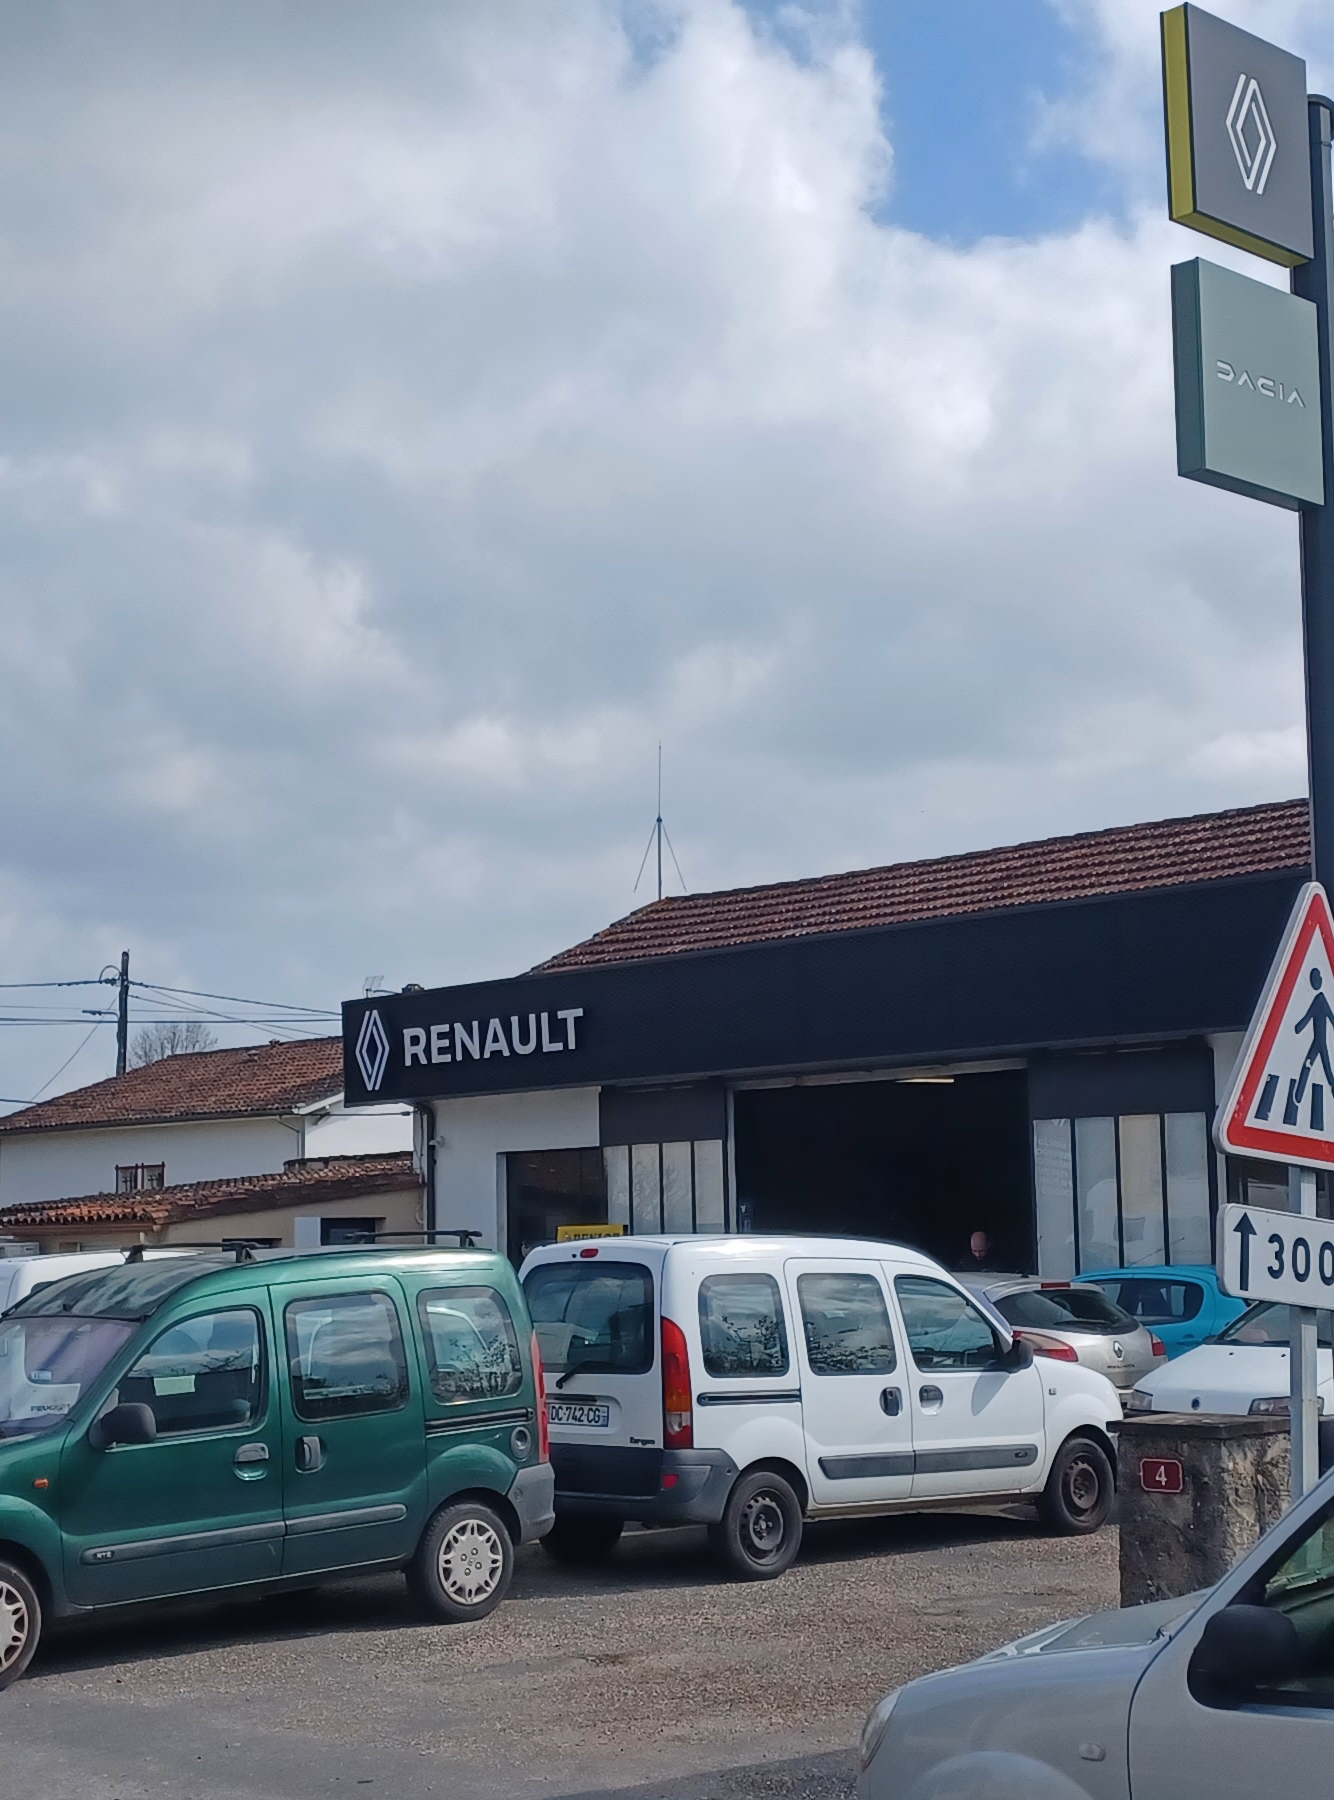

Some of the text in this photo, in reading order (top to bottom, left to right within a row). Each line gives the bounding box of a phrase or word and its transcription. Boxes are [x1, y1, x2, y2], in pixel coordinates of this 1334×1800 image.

[1217, 359, 1306, 408] DACIA
[403, 1007, 584, 1067] RENAULT
[1155, 1465, 1168, 1486] 4
